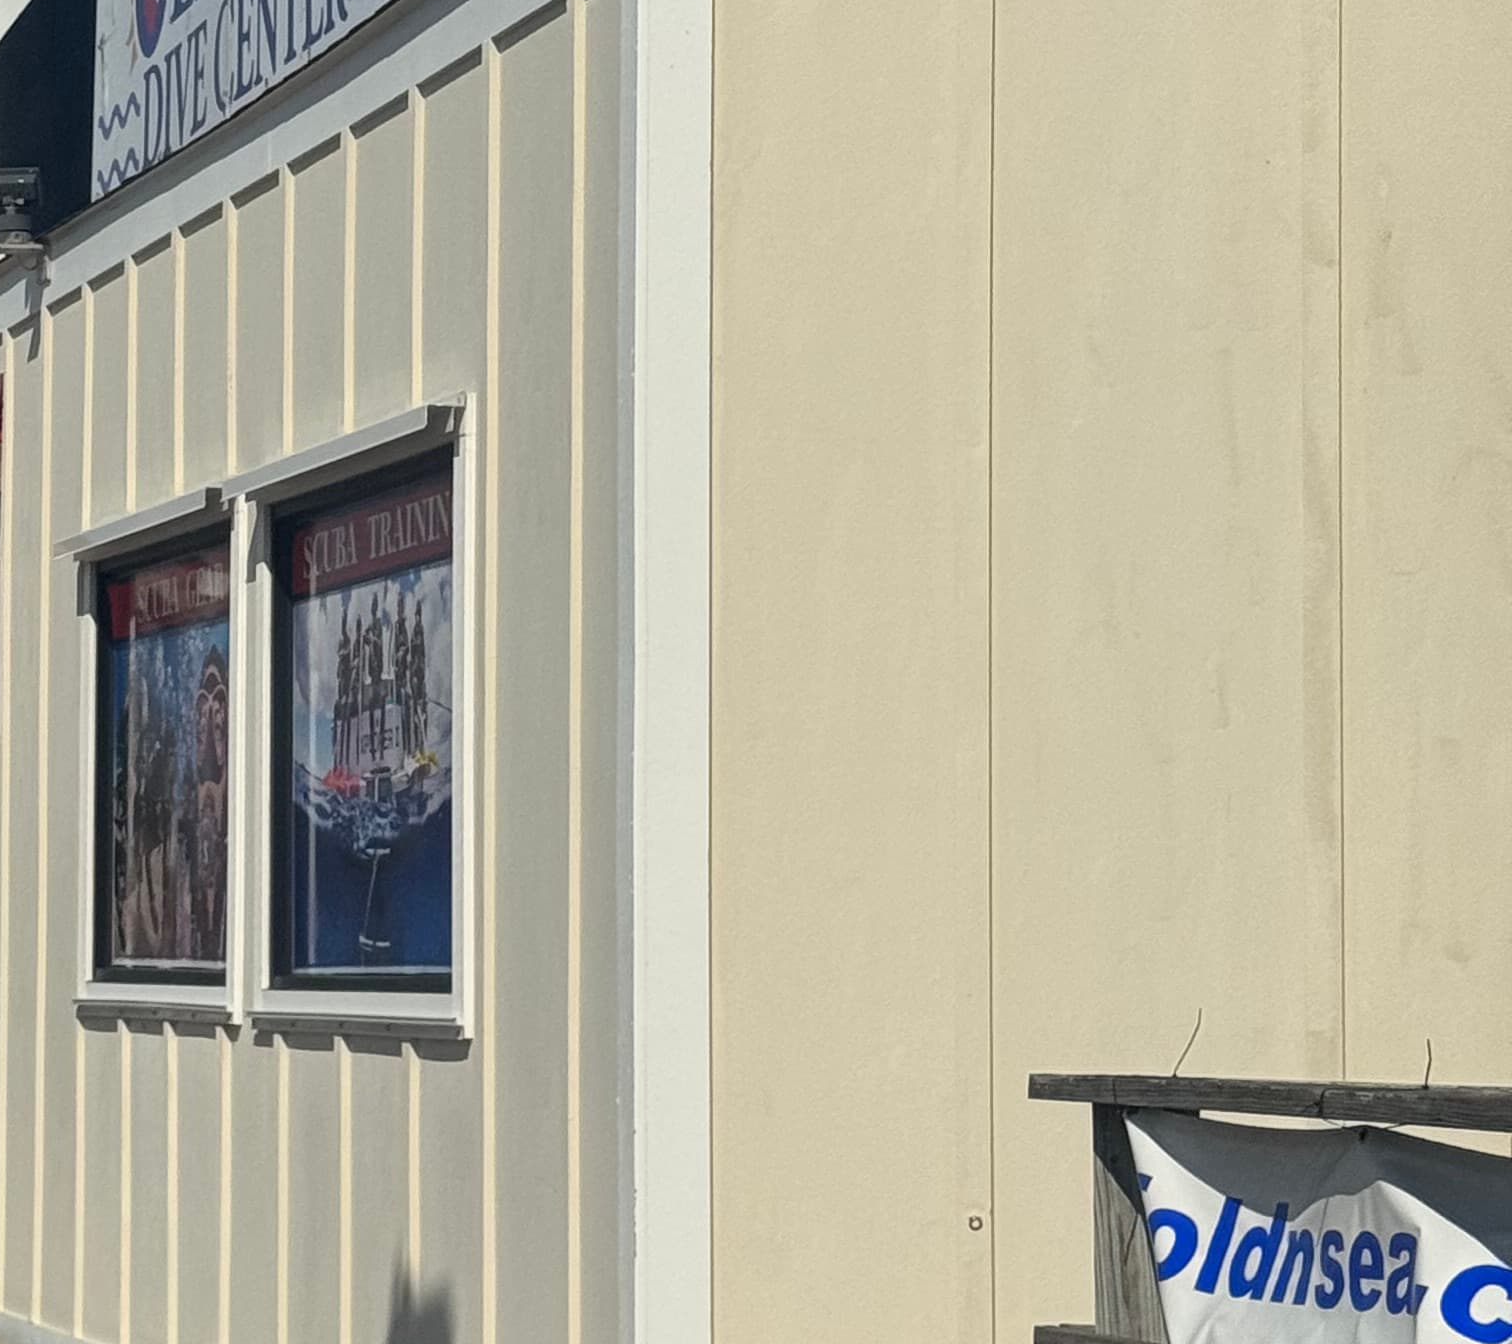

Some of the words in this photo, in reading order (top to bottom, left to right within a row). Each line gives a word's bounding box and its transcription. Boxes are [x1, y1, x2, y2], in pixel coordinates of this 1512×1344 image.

[140, 18, 208, 168] DIVE
[303, 522, 359, 580] SCUBA
[136, 576, 180, 623] SCUBA
